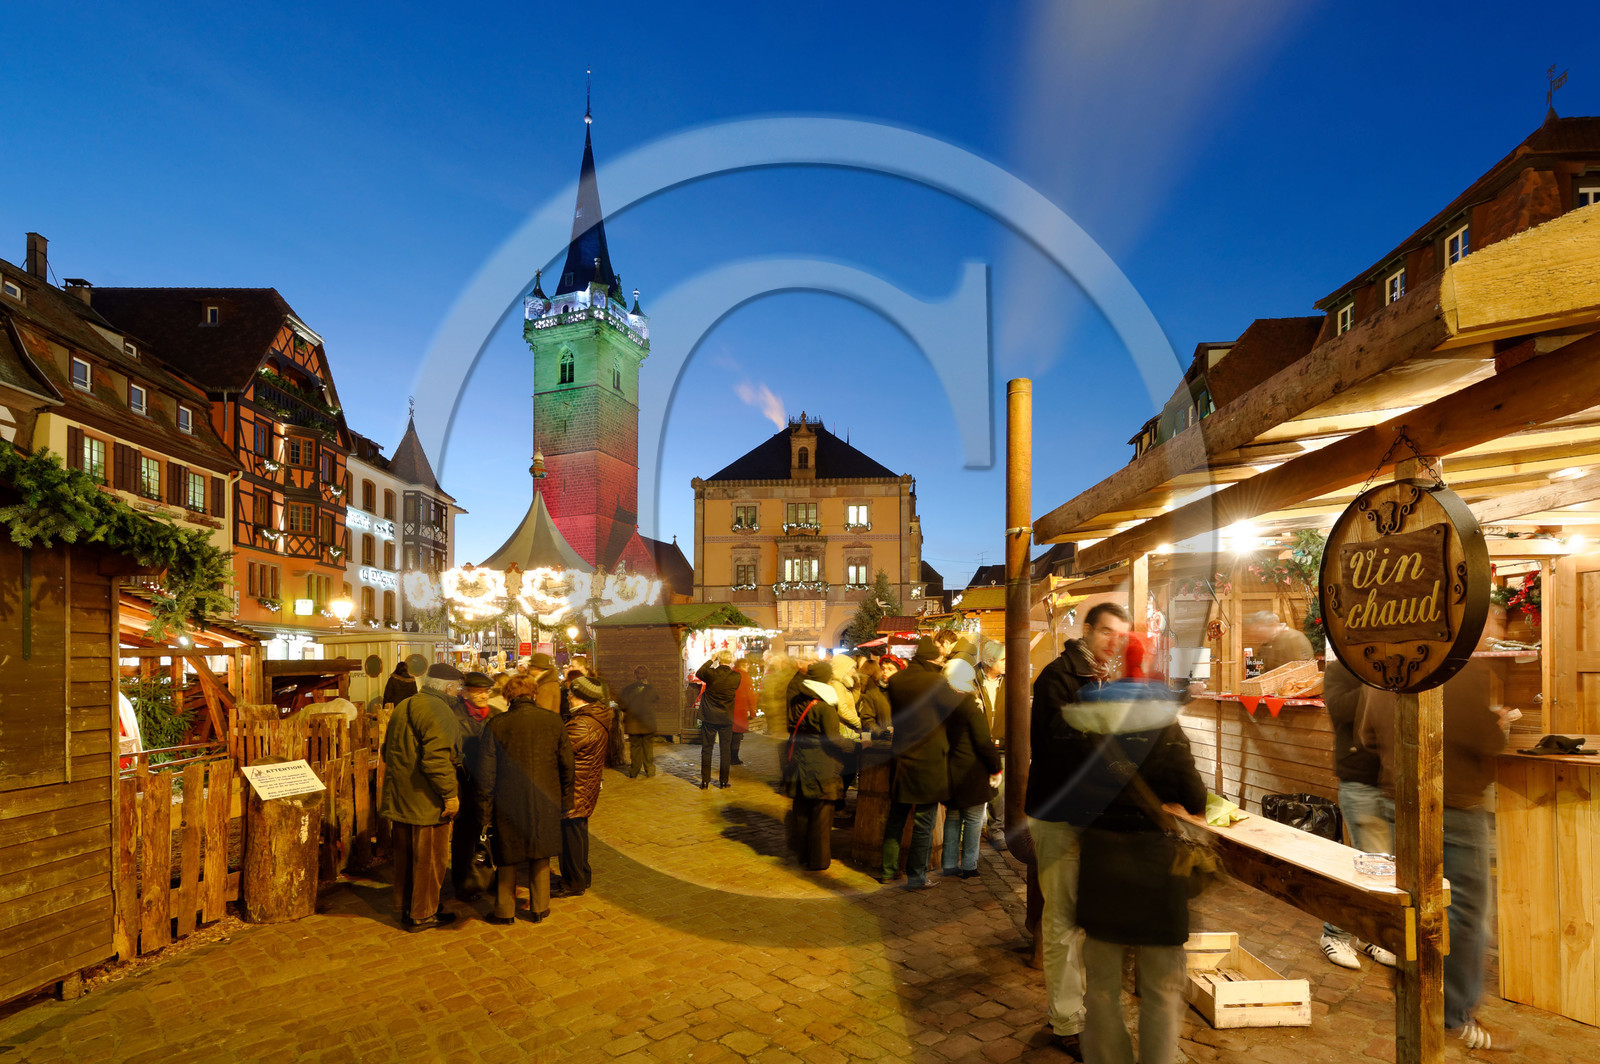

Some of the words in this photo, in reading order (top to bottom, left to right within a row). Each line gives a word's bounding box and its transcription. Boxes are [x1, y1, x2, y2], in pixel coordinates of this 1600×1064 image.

[1487, 526, 1504, 535] 22
[1349, 548, 1425, 589] Vin
[1344, 580, 1441, 629] chaud
[265, 765, 302, 774] ATTENTION
